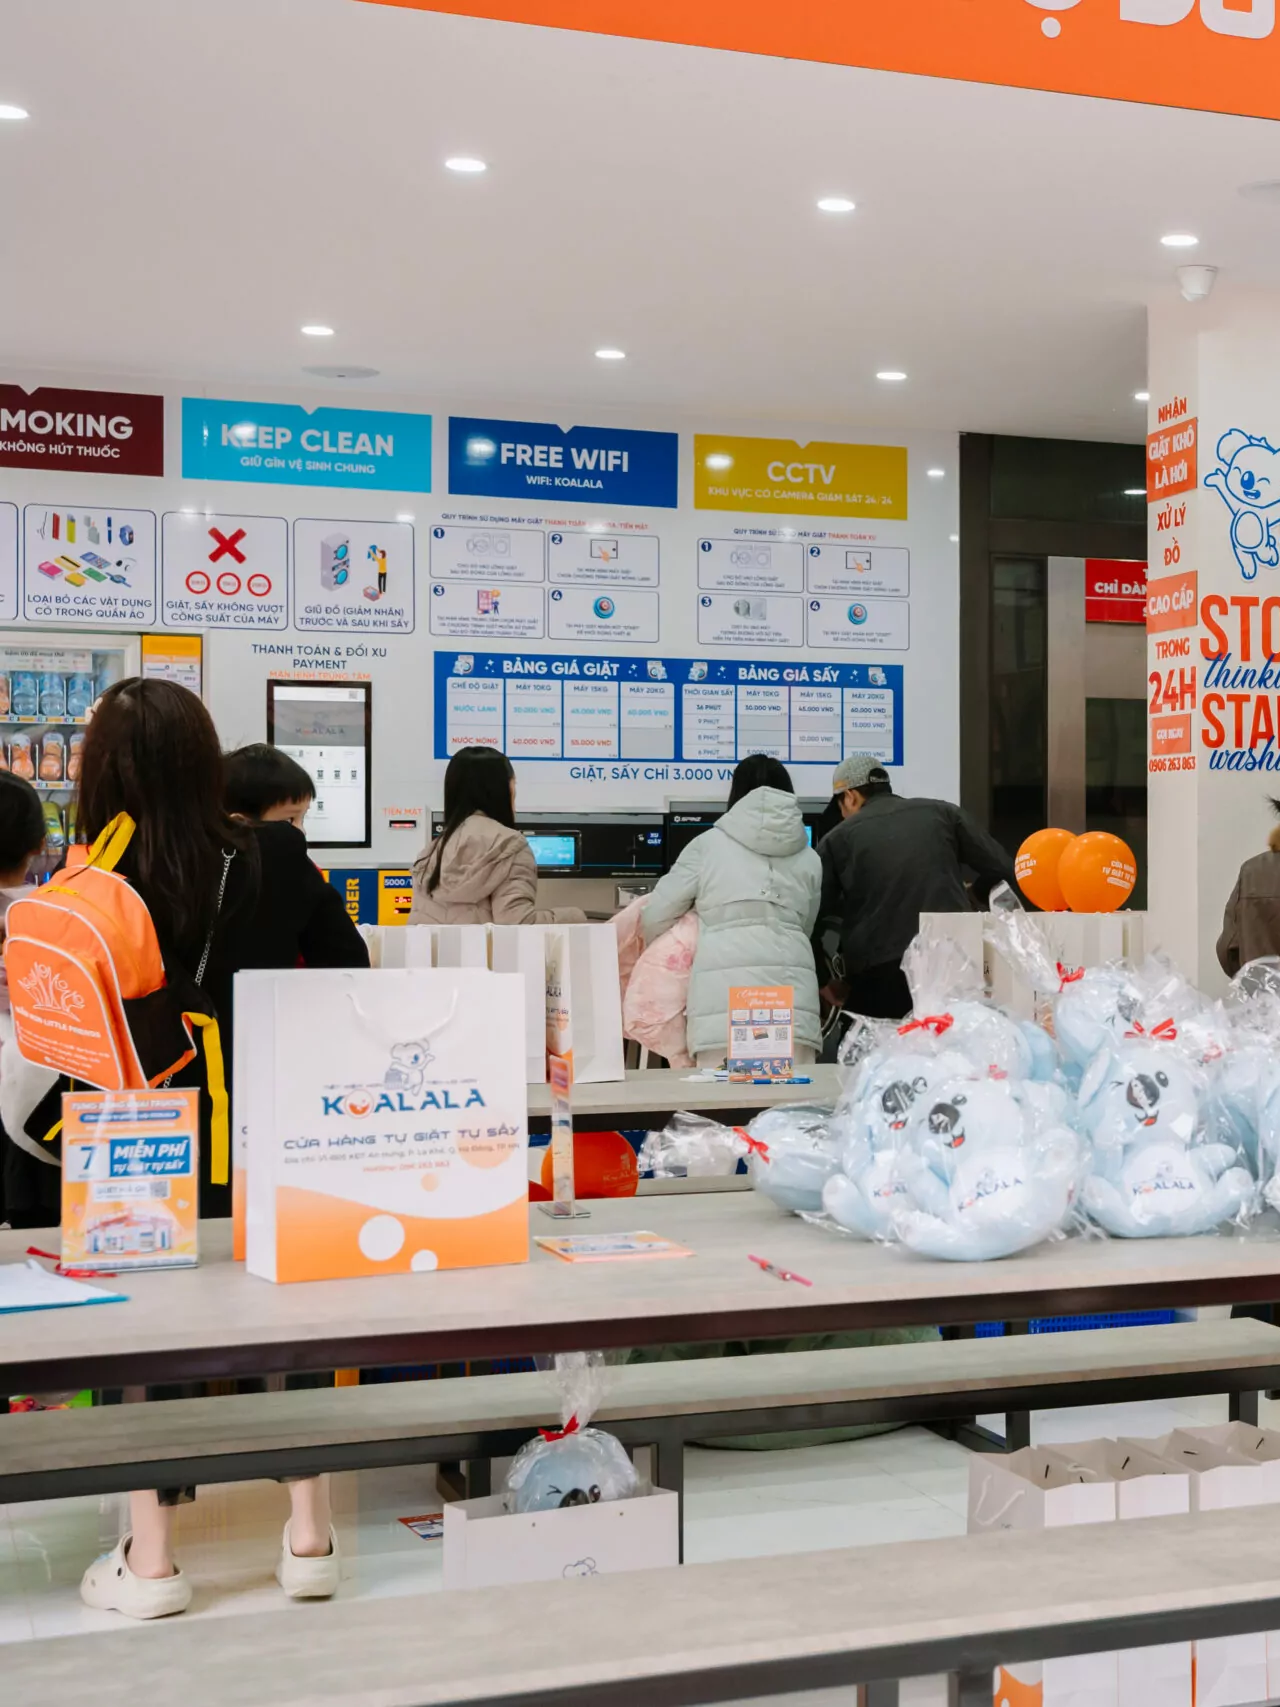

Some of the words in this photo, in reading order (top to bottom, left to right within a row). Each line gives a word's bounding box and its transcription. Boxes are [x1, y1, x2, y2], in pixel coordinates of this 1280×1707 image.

[1158, 396, 1187, 424] NHẬN
[0, 408, 133, 440] MOKING
[0, 440, 46, 454] KHÔNG
[49, 442, 74, 456] HÚT
[76, 444, 121, 459] THUỐC
[221, 423, 292, 449] KEEP
[300, 428, 394, 457] CLEAN
[1148, 431, 1170, 461] GIẶT
[1173, 424, 1194, 454] KHÔ
[240, 455, 262, 467] GIỮ
[264, 456, 286, 468] GÌN
[288, 458, 303, 472] VỆ
[305, 460, 332, 472] SINH
[334, 462, 376, 475] CHUNG
[500, 441, 564, 469] FREE
[571, 447, 629, 473] WIFI
[526, 474, 552, 487] WIFI:
[554, 476, 604, 490] KOALALA
[766, 460, 836, 485] CCTV
[1155, 464, 1169, 489] LÀ
[1170, 459, 1188, 482] HƠI
[1157, 502, 1172, 531] XỬ
[1174, 501, 1187, 527] LÝ
[1164, 537, 1180, 566] ĐỒ
[1094, 577, 1119, 595] CHỈ
[1148, 592, 1170, 616] CAO
[1172, 582, 1194, 611] CẤP
[251, 643, 293, 655] THANH
[297, 643, 333, 657] TOÁN
[335, 646, 342, 657] &
[372, 647, 388, 658] XU
[1155, 637, 1190, 660] TRONG
[293, 658, 348, 670] PAYMENT
[502, 656, 548, 674] BẢNG
[551, 657, 580, 676] GIÁ
[583, 660, 620, 680] GIẶT
[738, 664, 780, 681] BẢNG
[782, 665, 810, 682] GIÁ
[813, 665, 840, 683] SẤY
[1148, 665, 1197, 715] 24H
[570, 764, 607, 783] GIẶT,
[611, 763, 640, 780] SẤY
[644, 763, 669, 781] CHỈ
[673, 768, 713, 781] 3.000
[1149, 756, 1167, 773] 0906
[113, 1138, 156, 1160] MIỄN
[157, 1139, 189, 1157] PHÍ
[328, 1132, 376, 1147] HÀNG
[413, 1127, 451, 1144] GIẶT
[80, 1145, 97, 1171] 7
